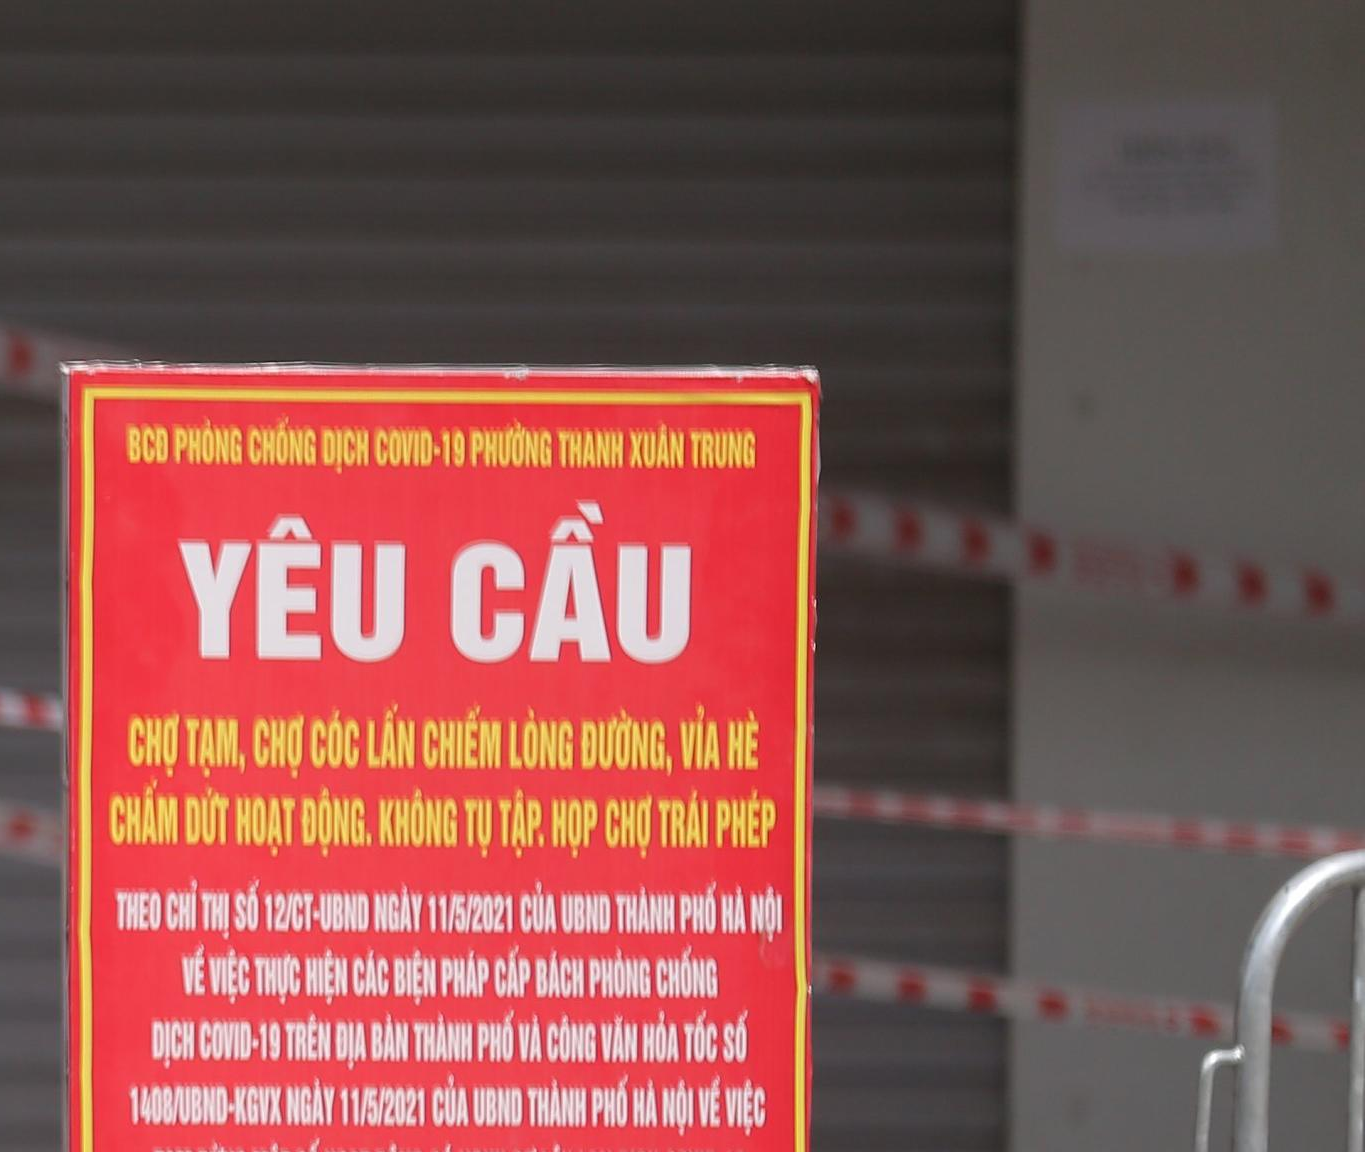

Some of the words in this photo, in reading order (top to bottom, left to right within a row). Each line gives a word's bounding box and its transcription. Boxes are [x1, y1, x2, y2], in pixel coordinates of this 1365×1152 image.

[127, 424, 168, 463] BCĐ
[174, 418, 242, 464] PHÒNG
[248, 416, 316, 465] CHỐNG
[322, 427, 369, 473] DỊCH
[374, 427, 465, 466] COVID-19
[470, 421, 551, 467] PHƯỜNG
[559, 429, 623, 467] THANH
[630, 423, 684, 467] XUÂN
[691, 429, 755, 468] TRUNG
[177, 514, 406, 662] YÊU
[449, 500, 692, 663] CẦU
[129, 712, 179, 777] CHỢ
[185, 716, 245, 777] TẠM,
[253, 713, 304, 778] CHỢ
[310, 709, 359, 768] CÓC
[367, 702, 415, 768] LẤN
[422, 705, 501, 768] CHIẾM
[509, 707, 573, 769] LÒNG
[581, 708, 672, 774] ĐƯỜNG,
[681, 704, 719, 769] VỈA
[728, 709, 758, 769] HÈ
[110, 779, 178, 844] CHẤM
[185, 786, 229, 845] DỨT
[236, 795, 295, 856] HOẠT
[379, 787, 457, 847] KHÔNG
[464, 797, 492, 857] TỤ
[552, 797, 597, 858] HỌP
[605, 794, 652, 857] CHỢ
[658, 789, 708, 847] TRÁI
[716, 789, 775, 847] PHÉP
[116, 889, 161, 930] THEO
[165, 878, 197, 930] CHỈ
[201, 890, 229, 939] THỊ
[234, 878, 259, 931] SỐ
[265, 890, 369, 932] 12/CT-UBND
[374, 884, 422, 932] NGÀY
[428, 891, 512, 933] 11/5/2021
[520, 880, 556, 933] CỦA
[561, 892, 610, 933] UBND
[615, 885, 675, 933] THÀNH
[680, 881, 716, 933] PHỐ
[721, 885, 746, 933] HÀ
[751, 885, 782, 941] NỘI
[209, 947, 250, 1003] VIỆC
[254, 952, 300, 1004] THỰC
[305, 947, 348, 1004] HIỆN
[352, 948, 389, 996] CÁC
[393, 948, 436, 1004] BIỆN
[441, 949, 489, 997] PHÁP
[494, 944, 530, 997] CẤP
[535, 949, 584, 997] BÁCH
[589, 947, 651, 998] PHÒNG
[656, 944, 717, 998] CHỐNG
[152, 1018, 194, 1068] DỊCH
[199, 1019, 280, 1060] COVID-19
[285, 1012, 331, 1061] TRÊN
[335, 1019, 366, 1069] ĐỊA
[371, 1012, 408, 1061] BÀN
[413, 1013, 472, 1061] THÀNH
[477, 1008, 514, 1062] PHỐ
[518, 1013, 542, 1062] VÀ
[547, 1013, 596, 1062] CÔNG
[601, 1014, 637, 1062] VĂN
[684, 1009, 717, 1062] TỐC
[723, 1009, 747, 1062] SỐ
[130, 1083, 281, 1125] 1408/UBND-KGVX
[286, 1077, 334, 1125] NGÀY
[340, 1085, 425, 1126] 11/5/2021
[432, 1073, 468, 1126] CỦA
[473, 1085, 522, 1126] UBND
[527, 1078, 586, 1126] THÀNH
[592, 1074, 628, 1127] PHỐ
[633, 1078, 657, 1127] HÀ
[662, 1078, 693, 1135] NỘI
[725, 1078, 765, 1135] VIỆC
